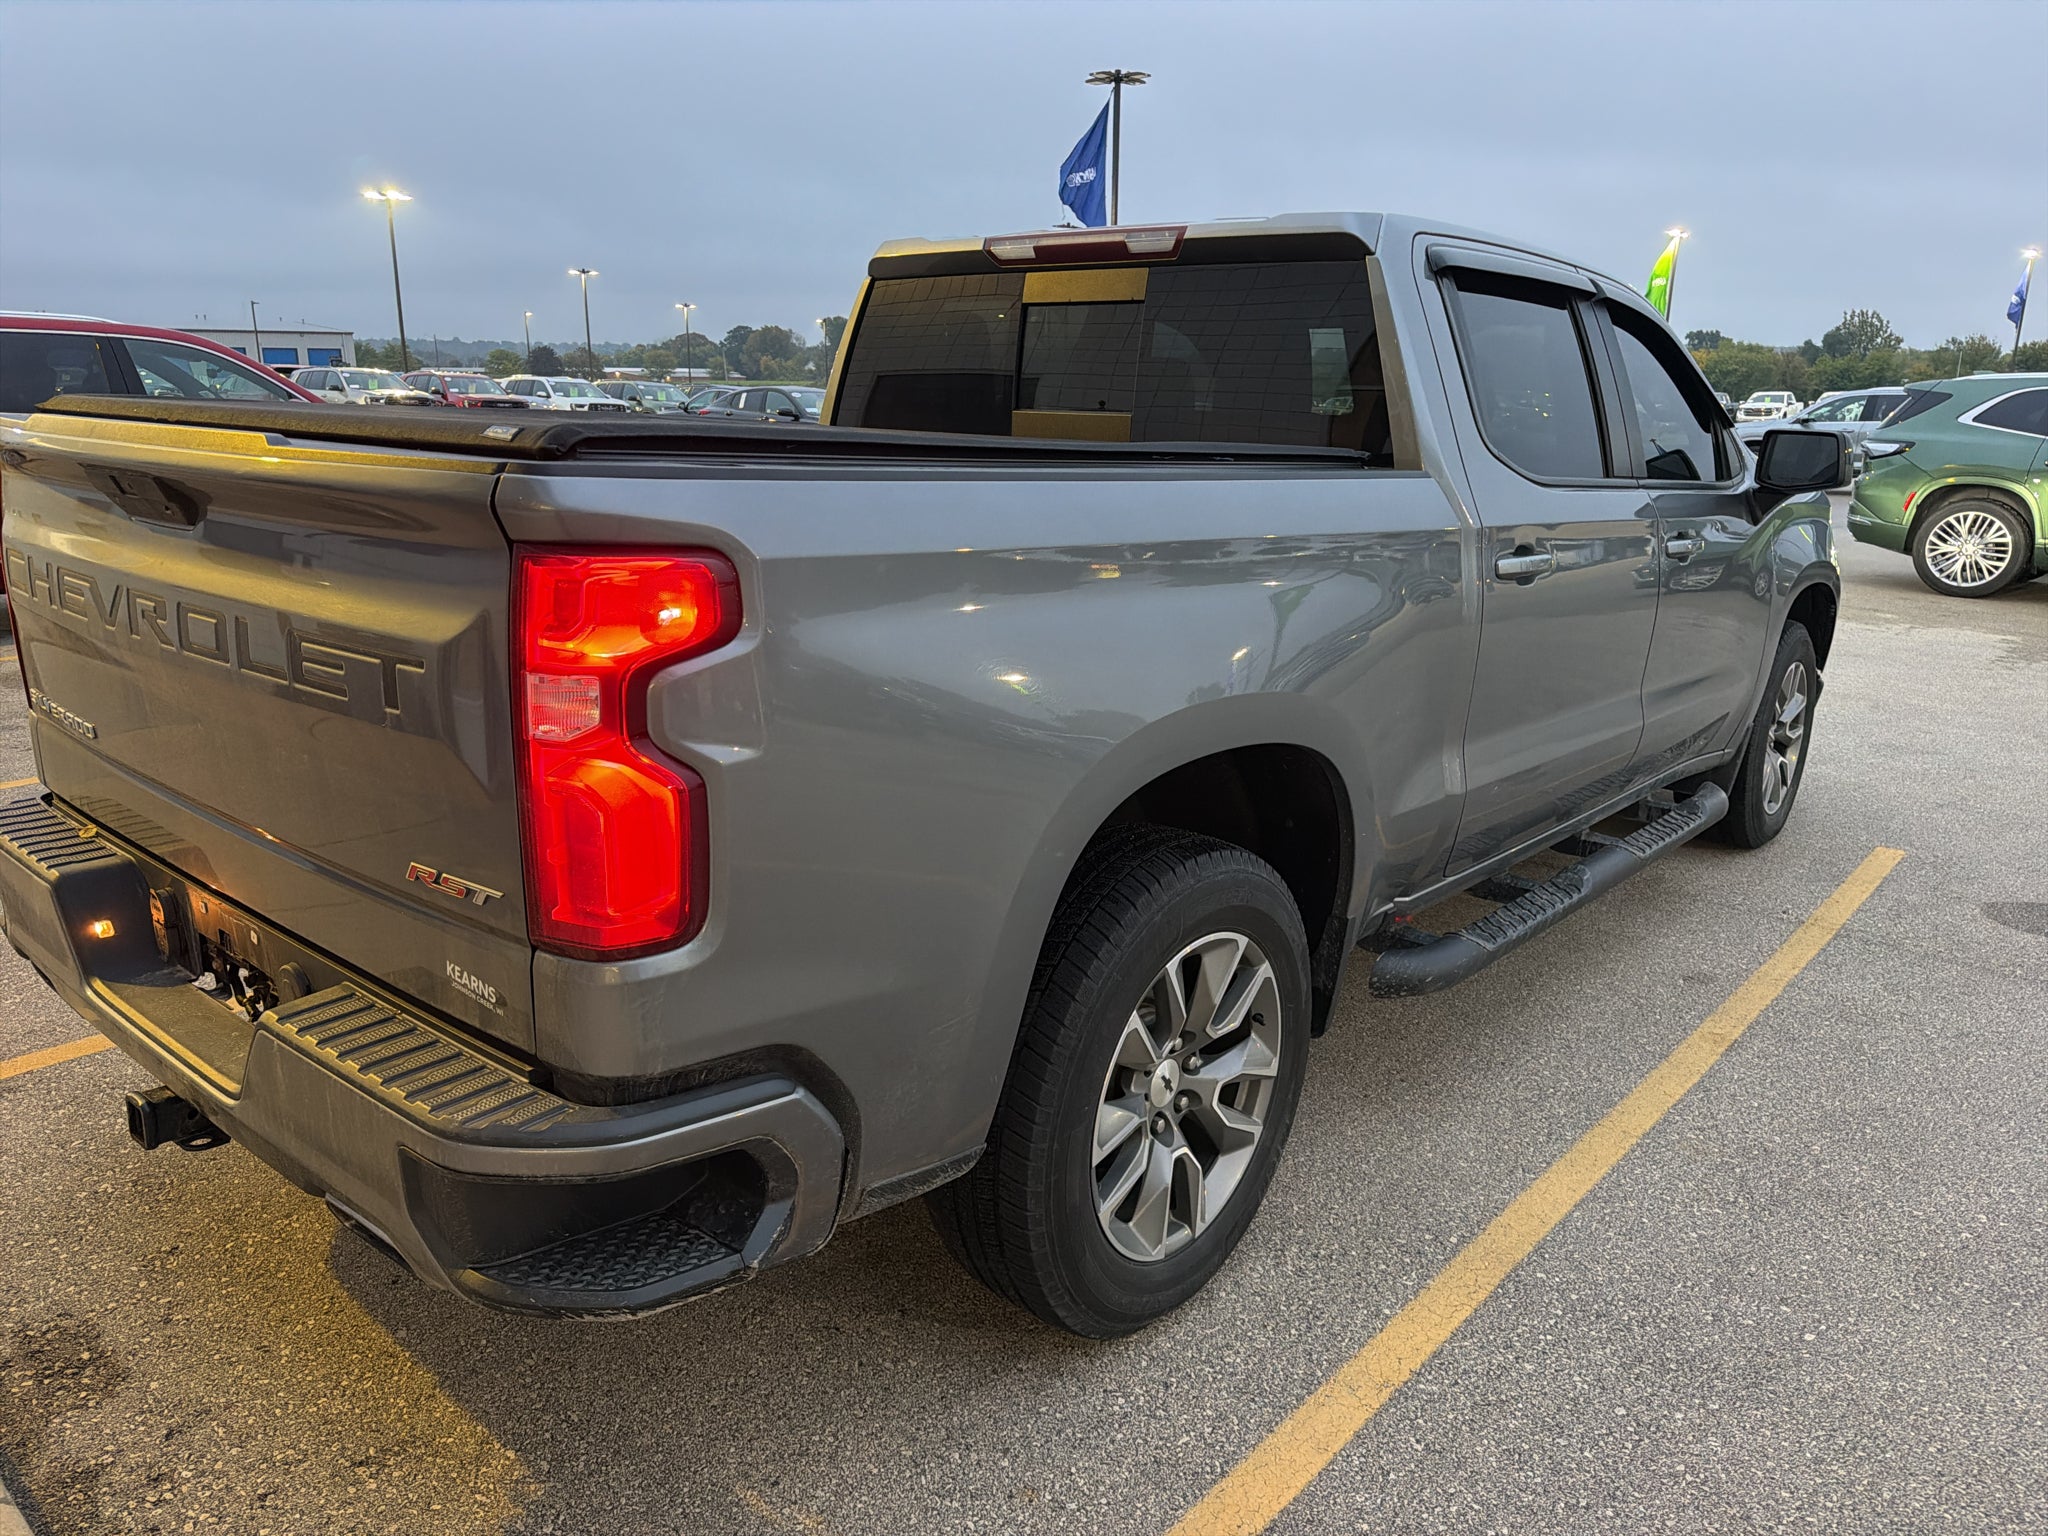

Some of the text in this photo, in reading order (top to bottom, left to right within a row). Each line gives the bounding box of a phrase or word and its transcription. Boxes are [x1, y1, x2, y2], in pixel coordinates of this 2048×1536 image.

[6, 547, 426, 714] CHEVROLET
[406, 861, 504, 906] RST
[446, 960, 497, 1003] KEARNS
[452, 981, 477, 1000] JOHNSON
